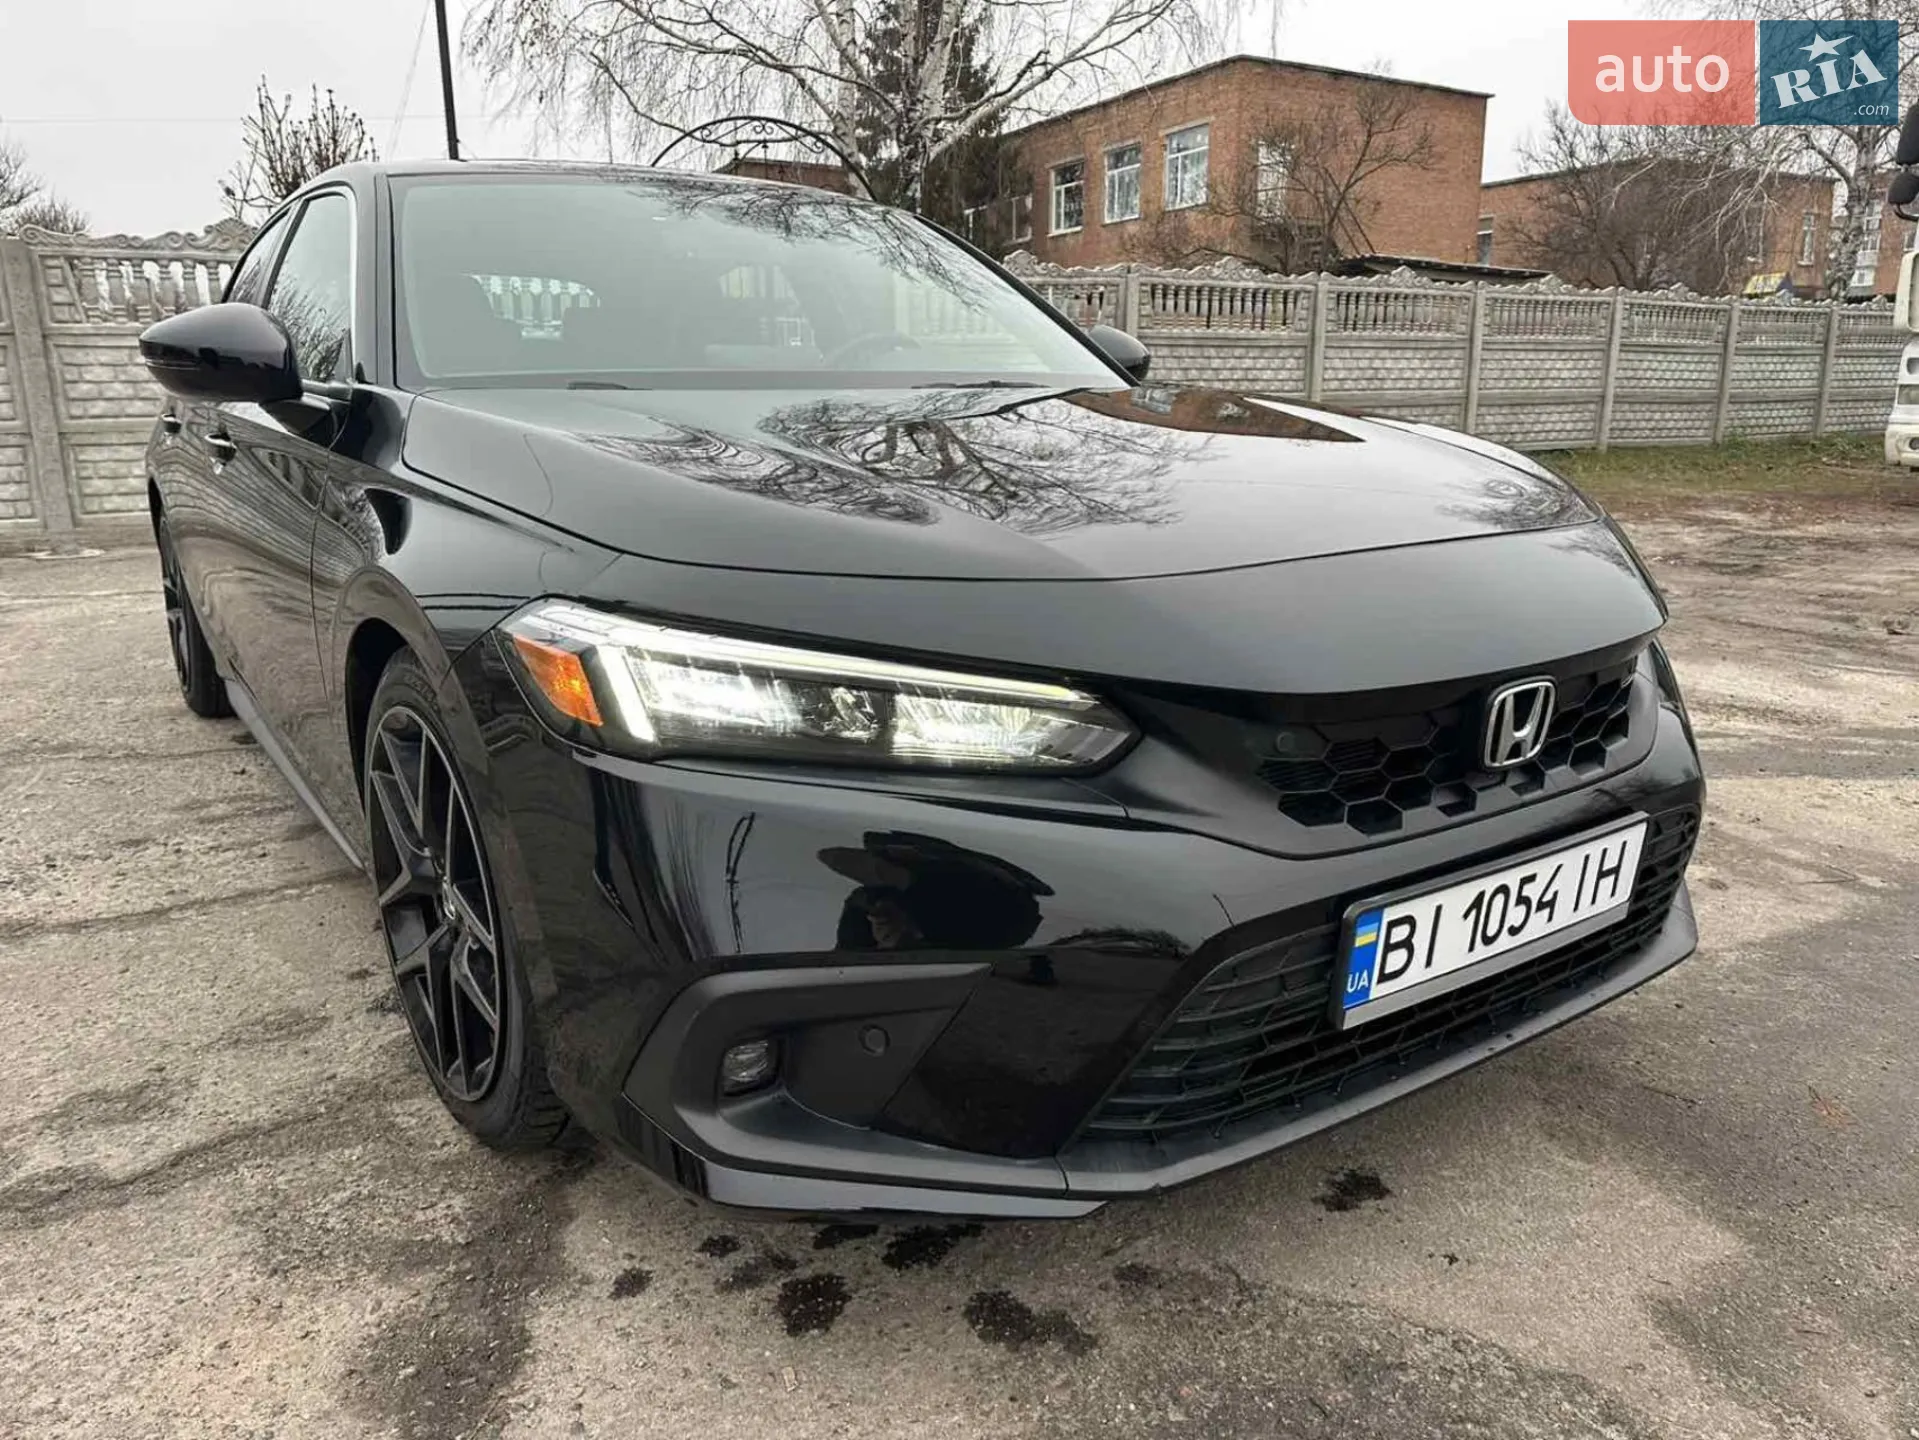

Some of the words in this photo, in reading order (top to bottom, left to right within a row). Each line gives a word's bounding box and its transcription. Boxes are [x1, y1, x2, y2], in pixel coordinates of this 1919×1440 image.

[1376, 904, 1443, 985] BI
[1462, 864, 1564, 954] 1054
[1573, 840, 1628, 912] IH
[1347, 971, 1370, 994] UA
